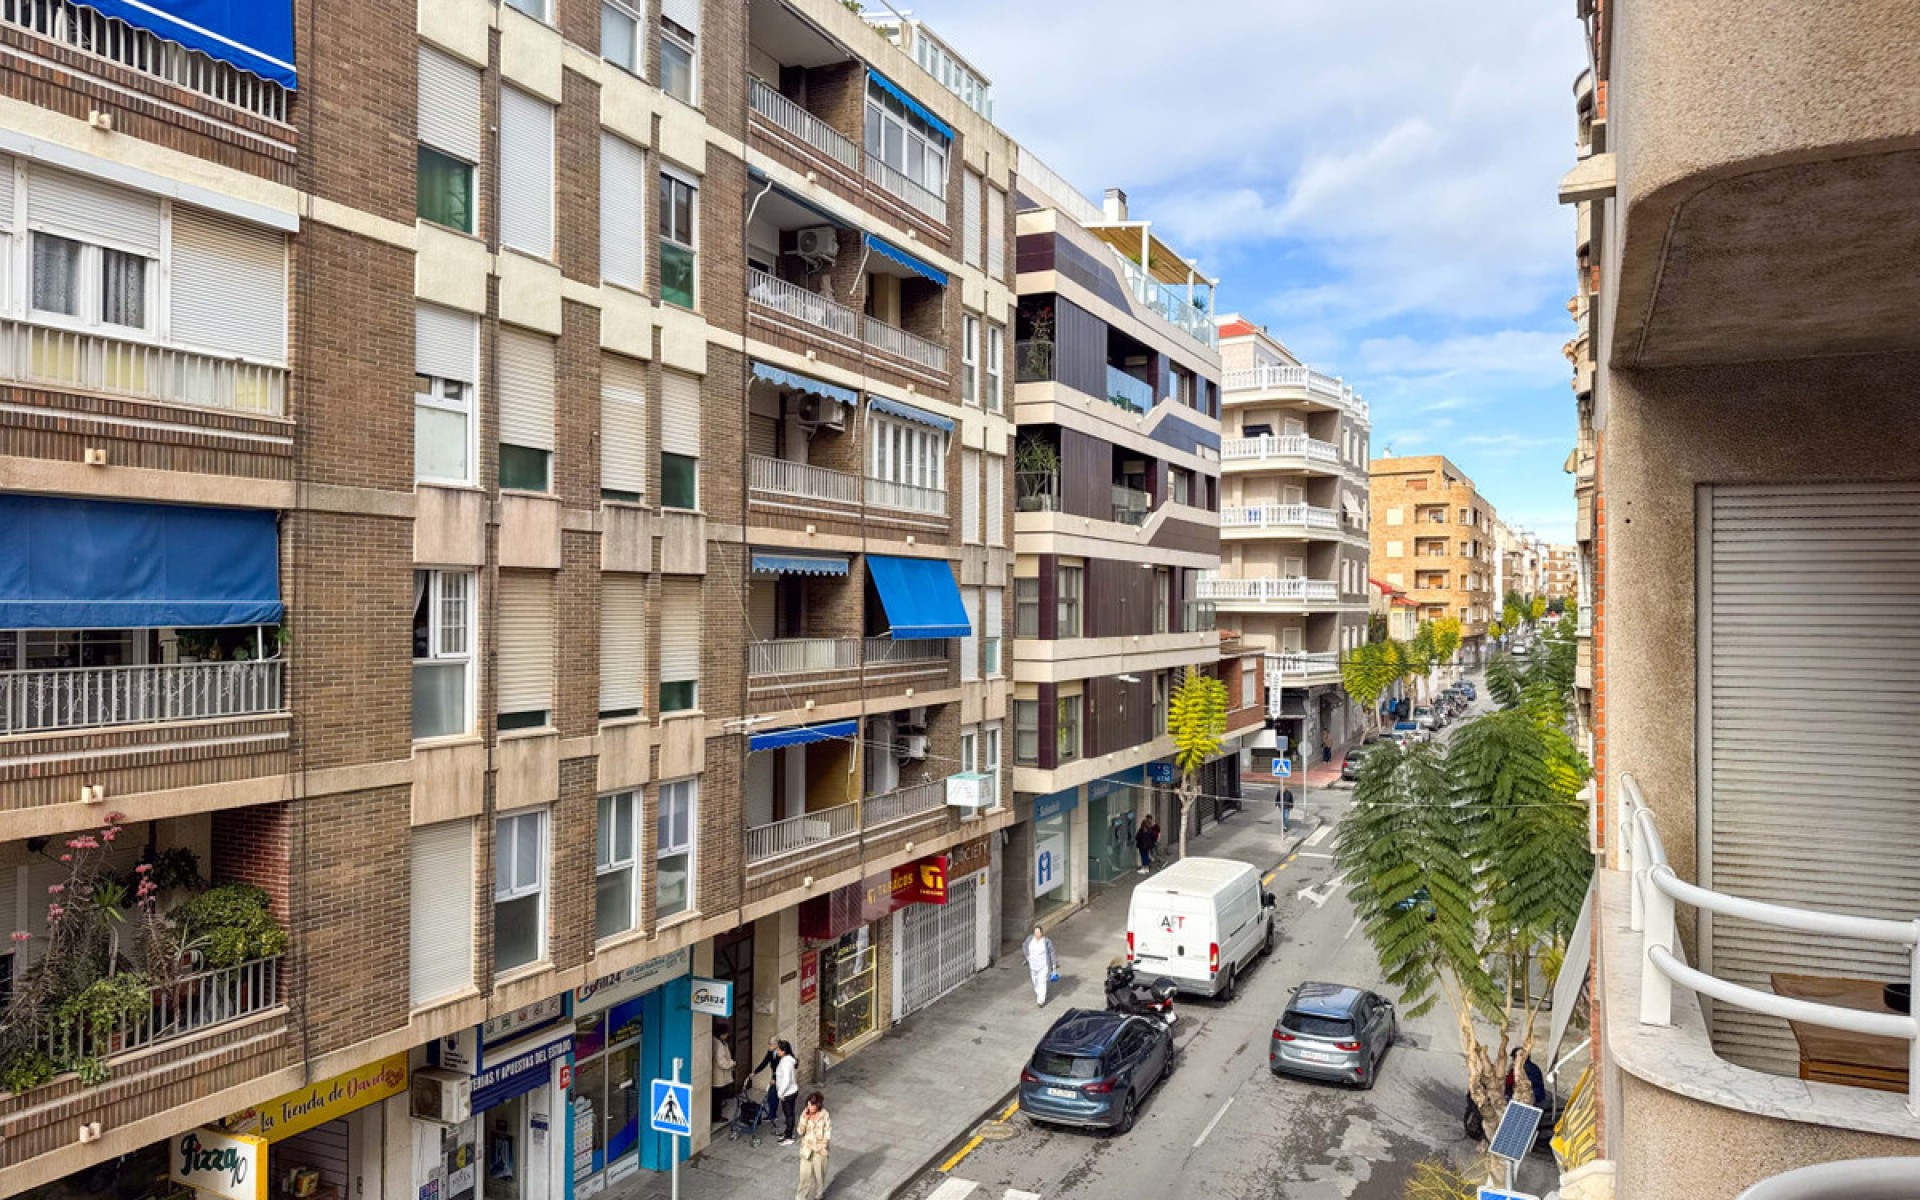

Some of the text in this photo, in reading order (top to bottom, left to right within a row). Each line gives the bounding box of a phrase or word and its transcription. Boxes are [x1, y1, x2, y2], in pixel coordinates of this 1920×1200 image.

[495, 1068, 500, 1083] Y
[501, 1055, 534, 1079] APUESTAS
[535, 1050, 547, 1065] DEL
[548, 1039, 572, 1060] ESTADO
[260, 1064, 385, 1134] La Tienda de David
[180, 1132, 239, 1177] Pizza
